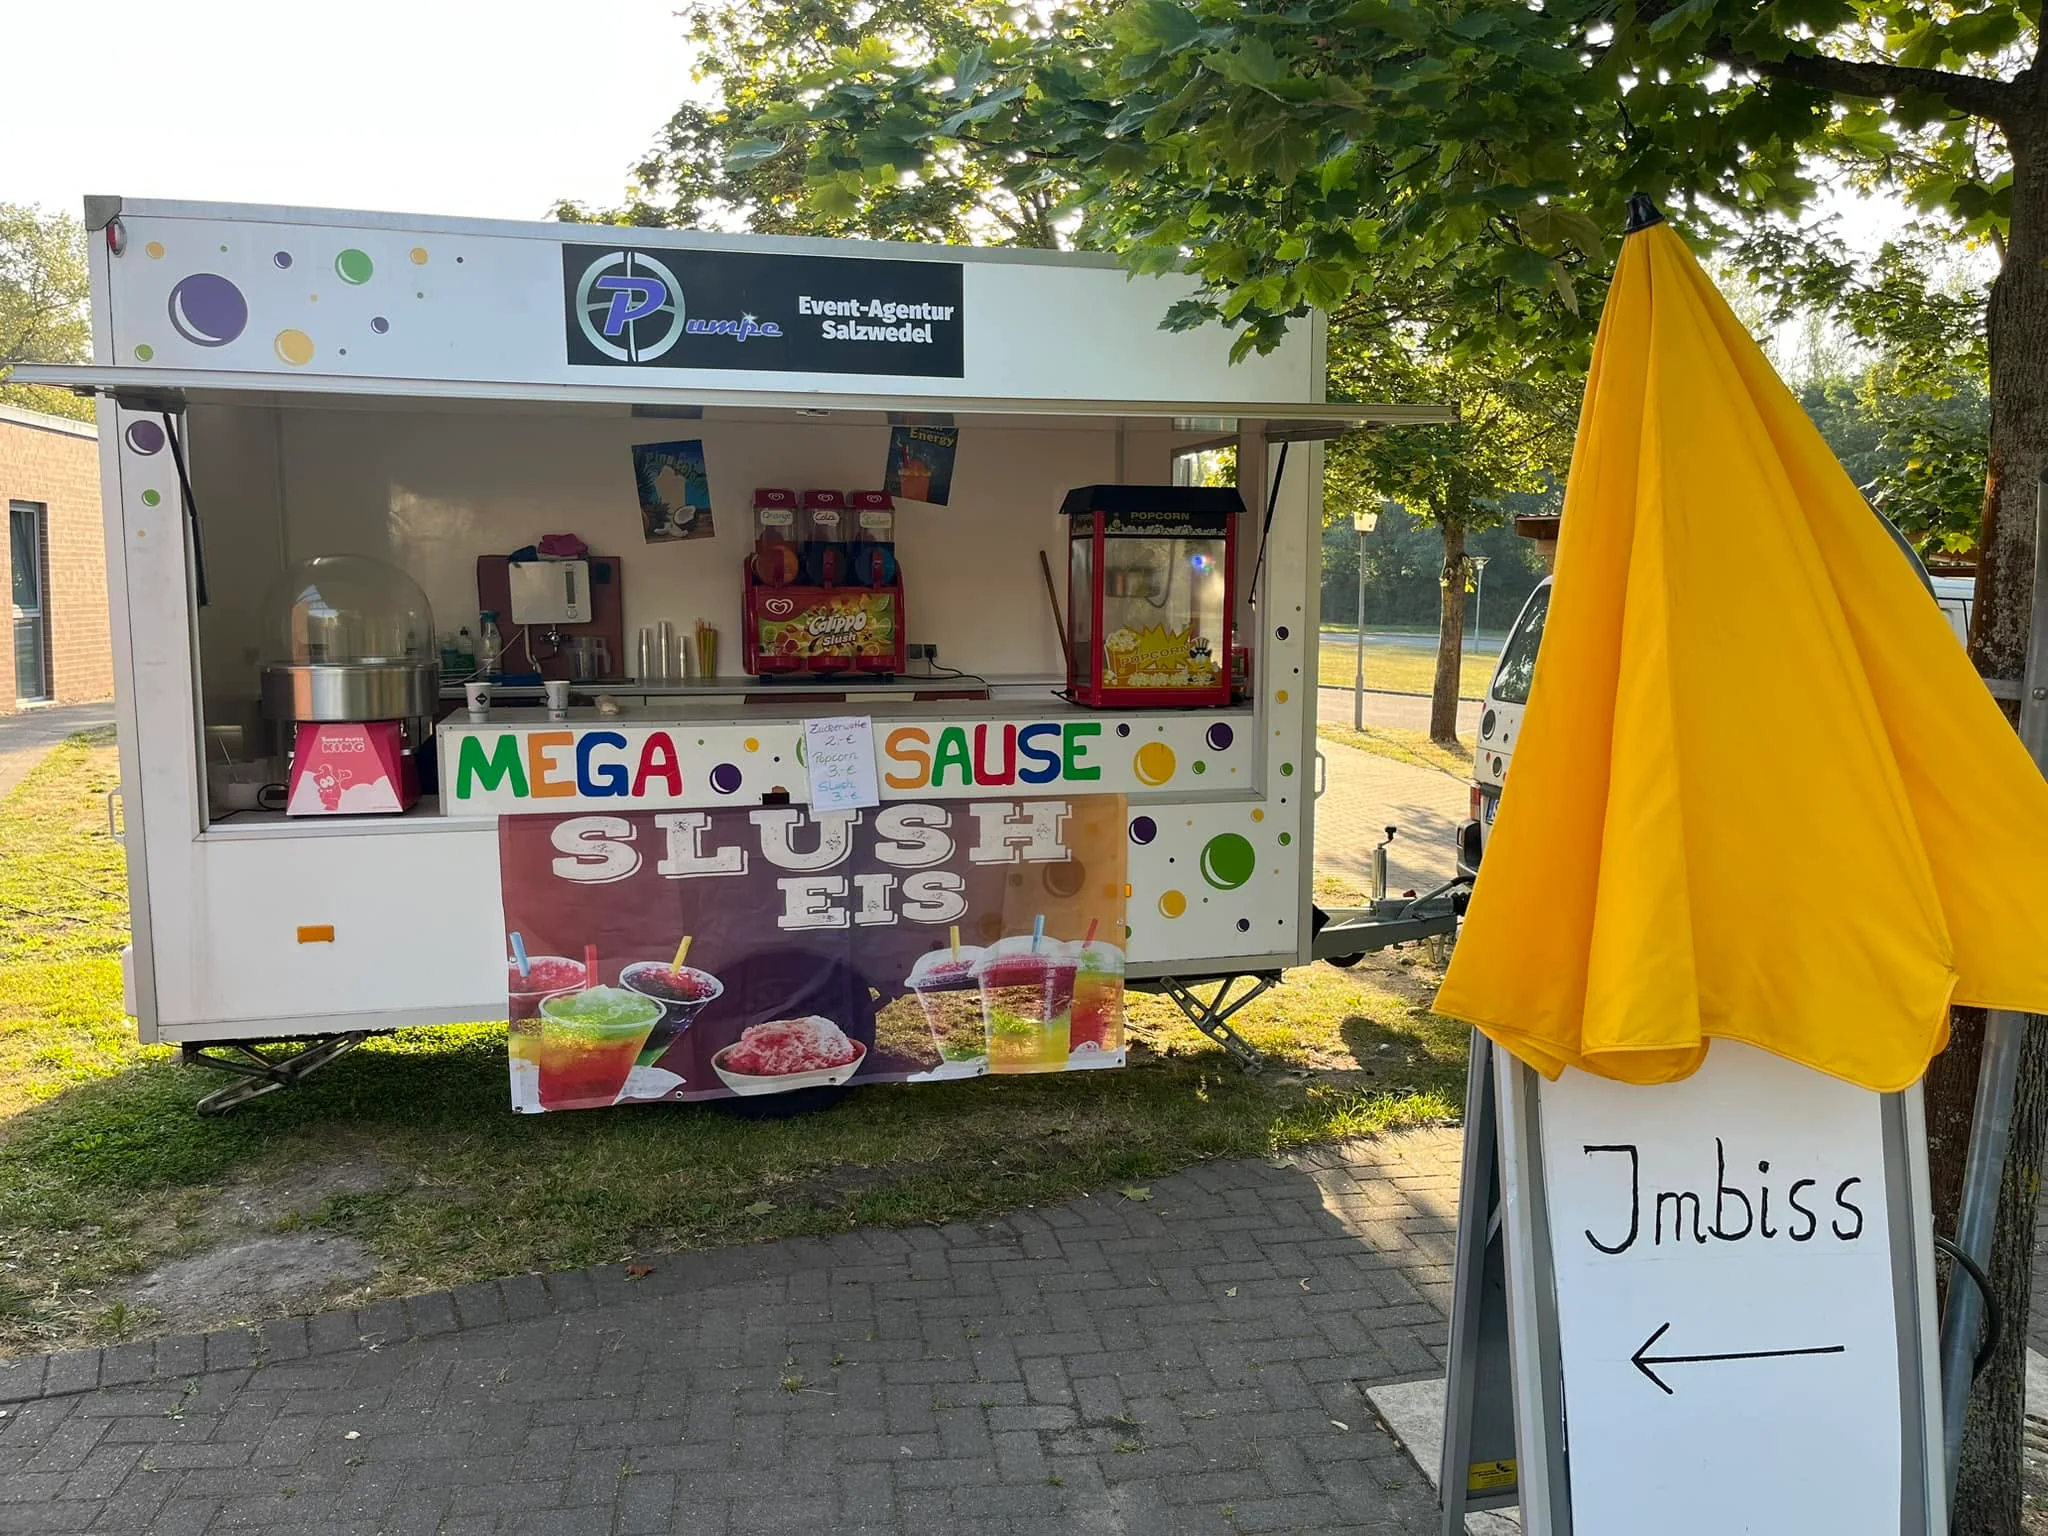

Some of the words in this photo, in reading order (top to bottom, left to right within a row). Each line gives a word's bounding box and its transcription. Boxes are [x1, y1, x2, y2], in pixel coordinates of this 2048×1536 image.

[798, 295, 955, 322] Event-Agentur
[821, 319, 933, 344] Salzwedel
[909, 427, 954, 447] Energy
[1130, 512, 1190, 521] POPCORN
[808, 612, 868, 636] Calippo
[1119, 644, 1191, 667] POPCORN
[321, 742, 365, 754] KING
[812, 751, 858, 766] Popcorn
[455, 730, 683, 800] MEGA
[884, 722, 1102, 789] SAUSE
[551, 800, 1072, 884] SLUSH
[776, 869, 970, 930] EIS
